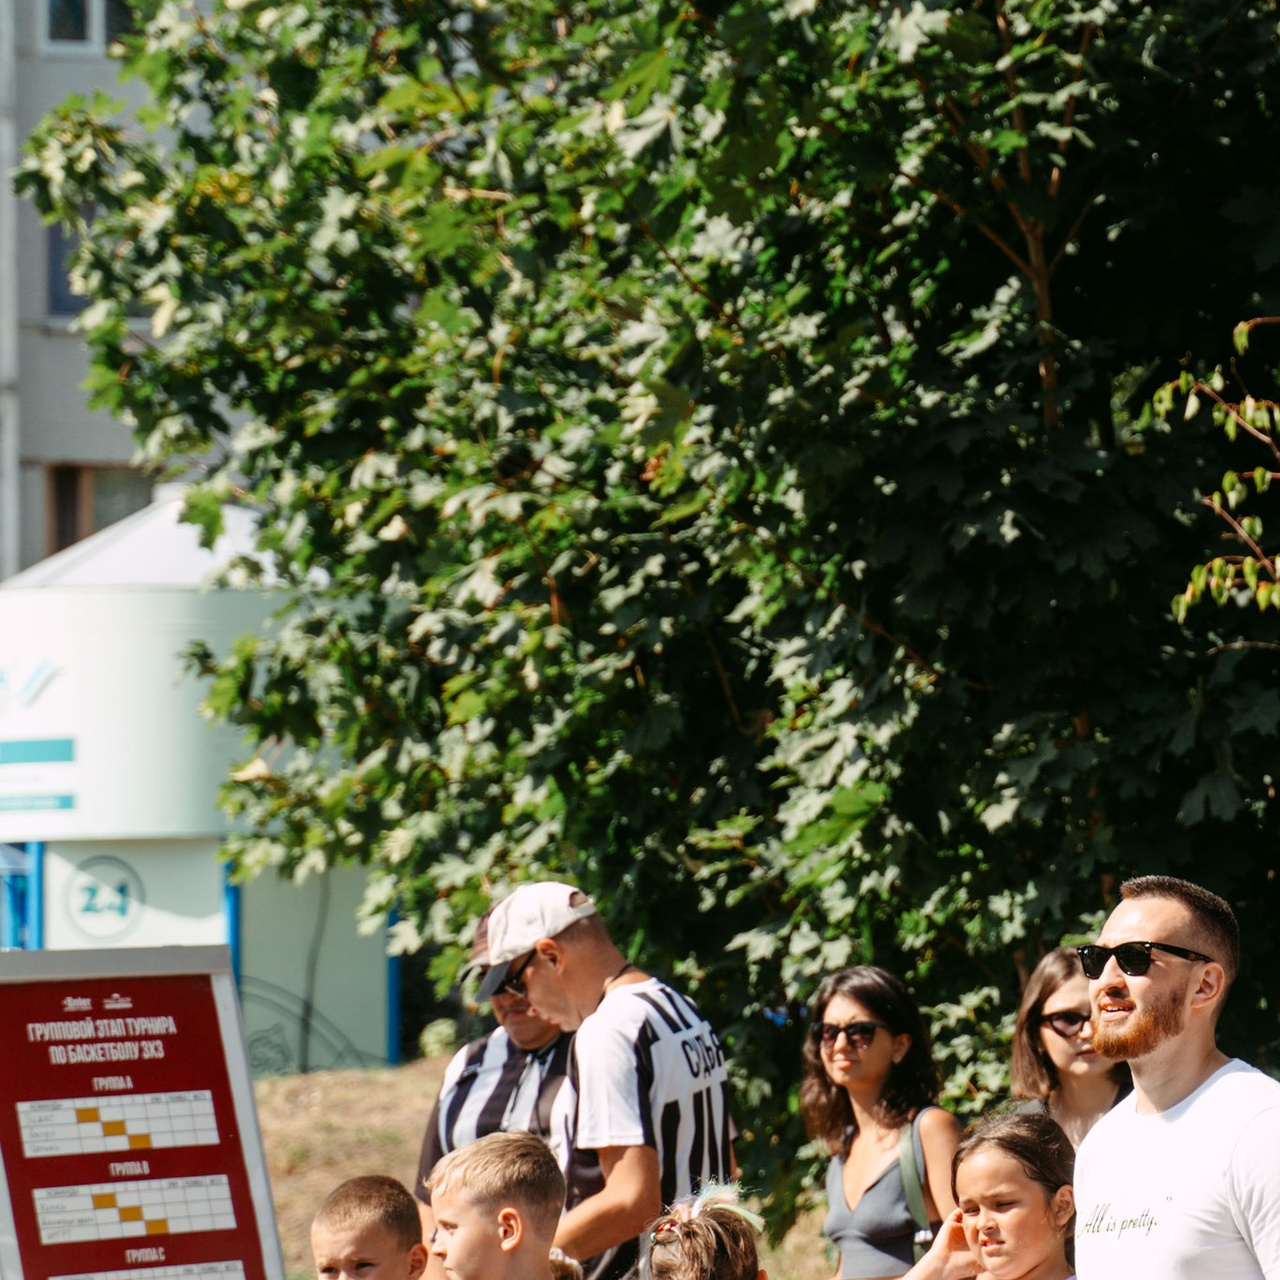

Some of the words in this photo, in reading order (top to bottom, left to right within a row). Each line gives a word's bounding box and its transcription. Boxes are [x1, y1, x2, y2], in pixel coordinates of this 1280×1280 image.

[26, 1017, 96, 1042] ГРУППОВОЙ
[95, 1018, 126, 1038] ЭТАП
[127, 1015, 177, 1035] ТУРНИРА
[49, 1045, 67, 1065] ПО
[67, 1041, 139, 1064] БАСКЕТБОЛУ
[92, 1076, 125, 1091] ГРУППА
[109, 1161, 142, 1177] ГРУППА
[1077, 1202, 1111, 1238] All
[1106, 1216, 1116, 1232] is
[125, 1247, 159, 1264] ГРУППА
